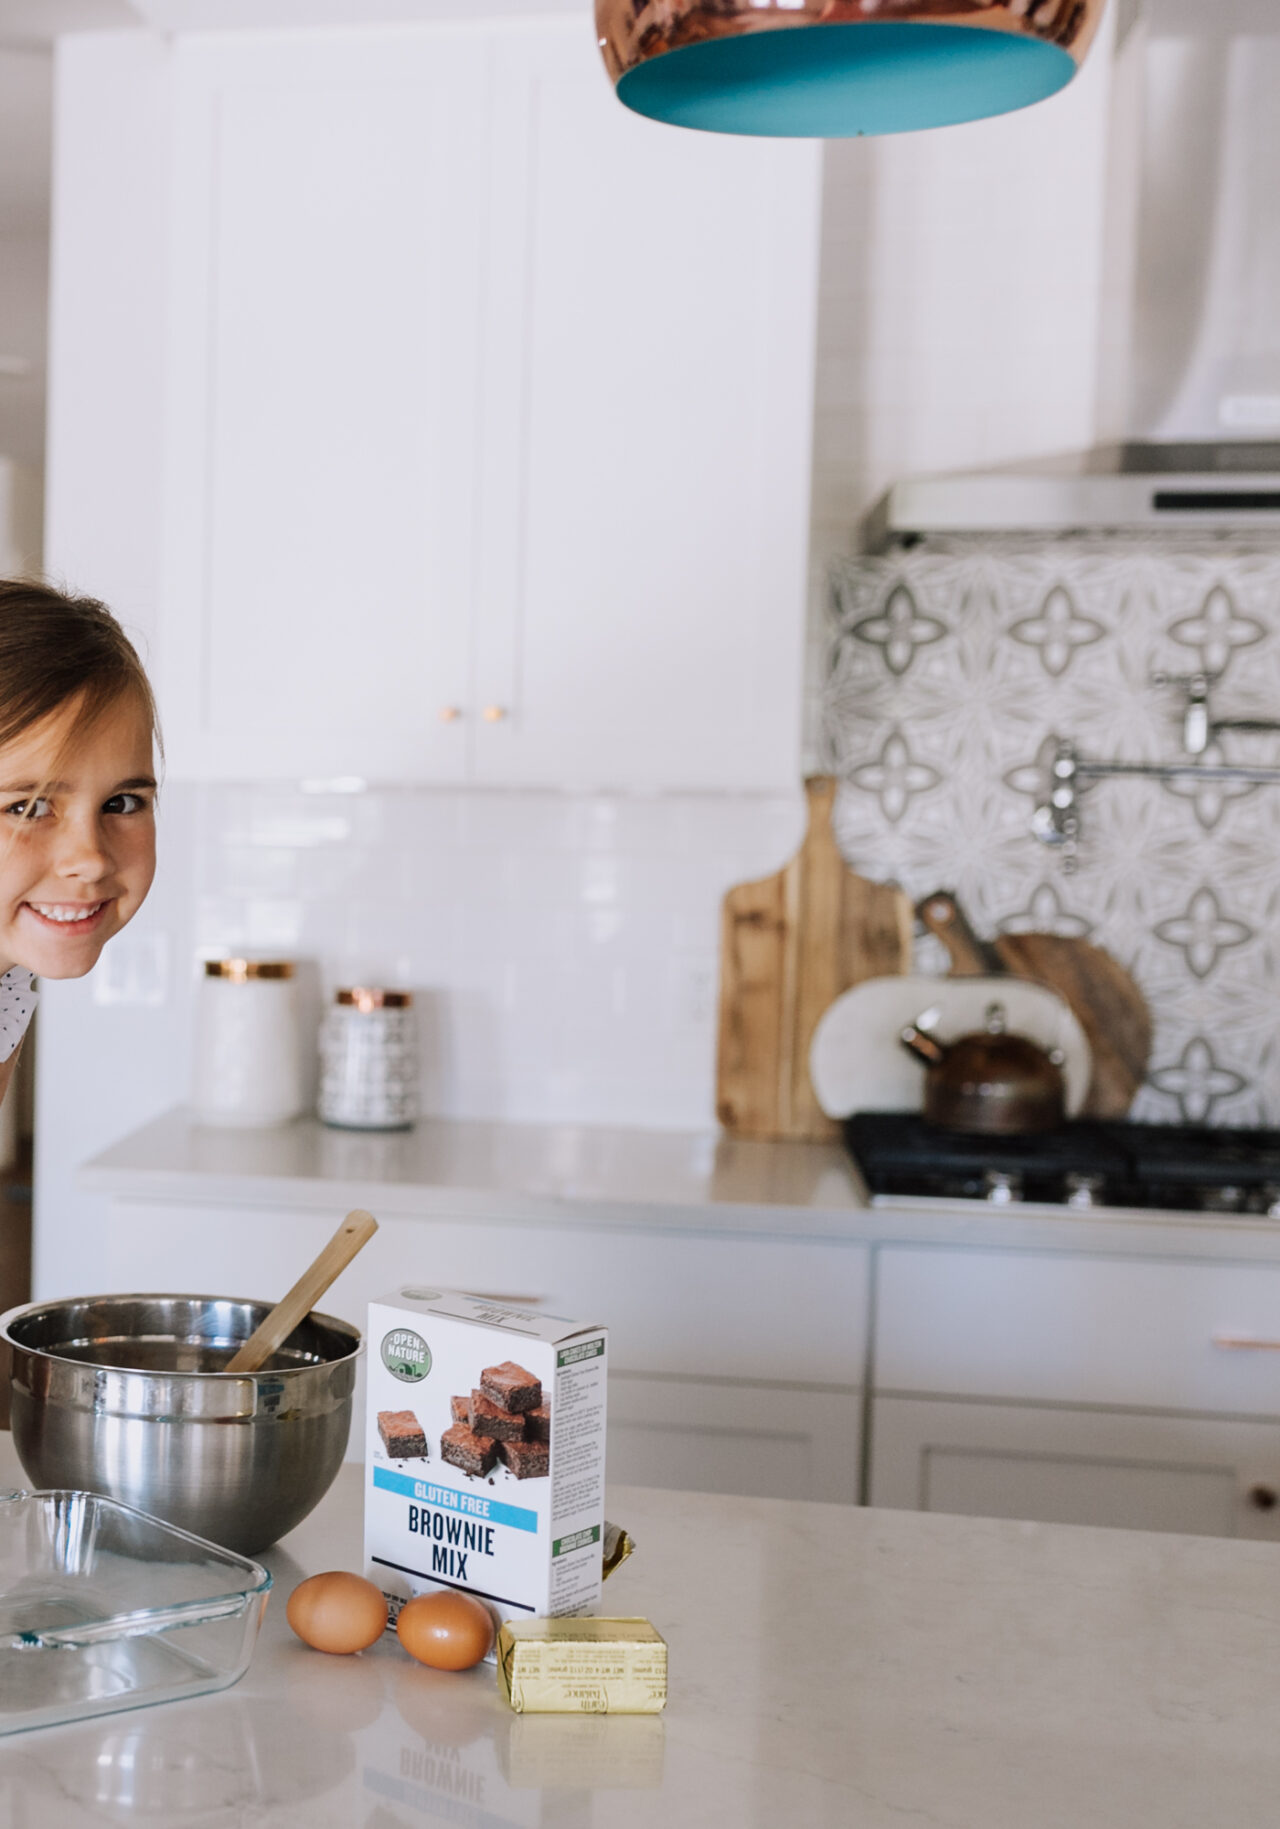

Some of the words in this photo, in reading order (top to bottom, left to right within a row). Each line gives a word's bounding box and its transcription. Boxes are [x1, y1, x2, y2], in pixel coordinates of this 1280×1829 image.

[477, 1312, 506, 1323] MIX
[388, 1344, 425, 1364] NATURE
[393, 1333, 420, 1350] OPEN
[414, 1481, 458, 1509] GLUTEN
[461, 1494, 490, 1518] FREE
[408, 1504, 495, 1557] BROWNIE
[432, 1544, 468, 1581] MIX
